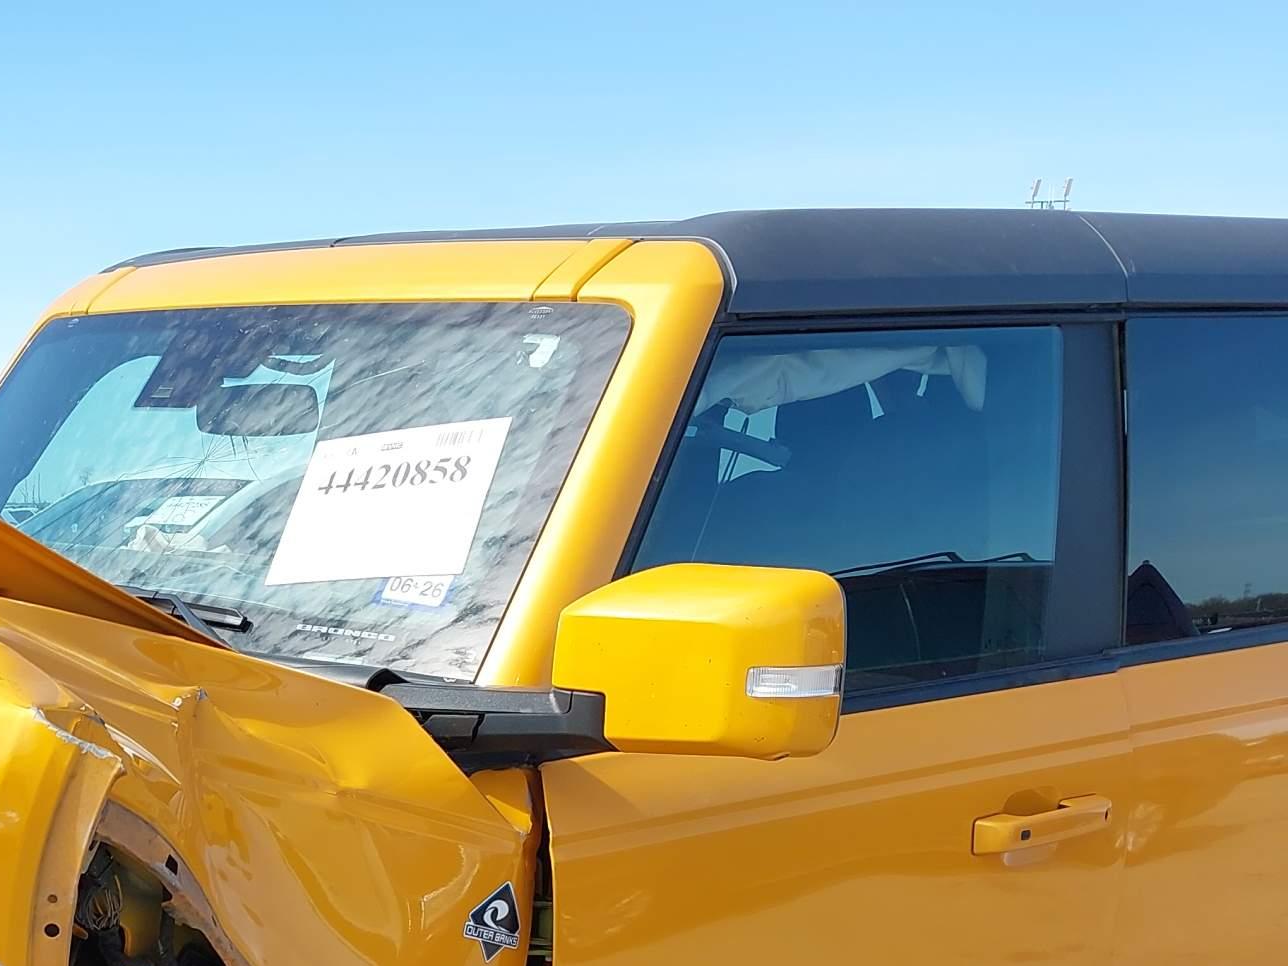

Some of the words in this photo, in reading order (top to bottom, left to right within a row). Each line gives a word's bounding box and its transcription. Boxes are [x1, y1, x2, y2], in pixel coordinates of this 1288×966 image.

[317, 455, 471, 495] 44420858
[466, 926, 494, 940] OUTER
[495, 933, 518, 946] BANKS
